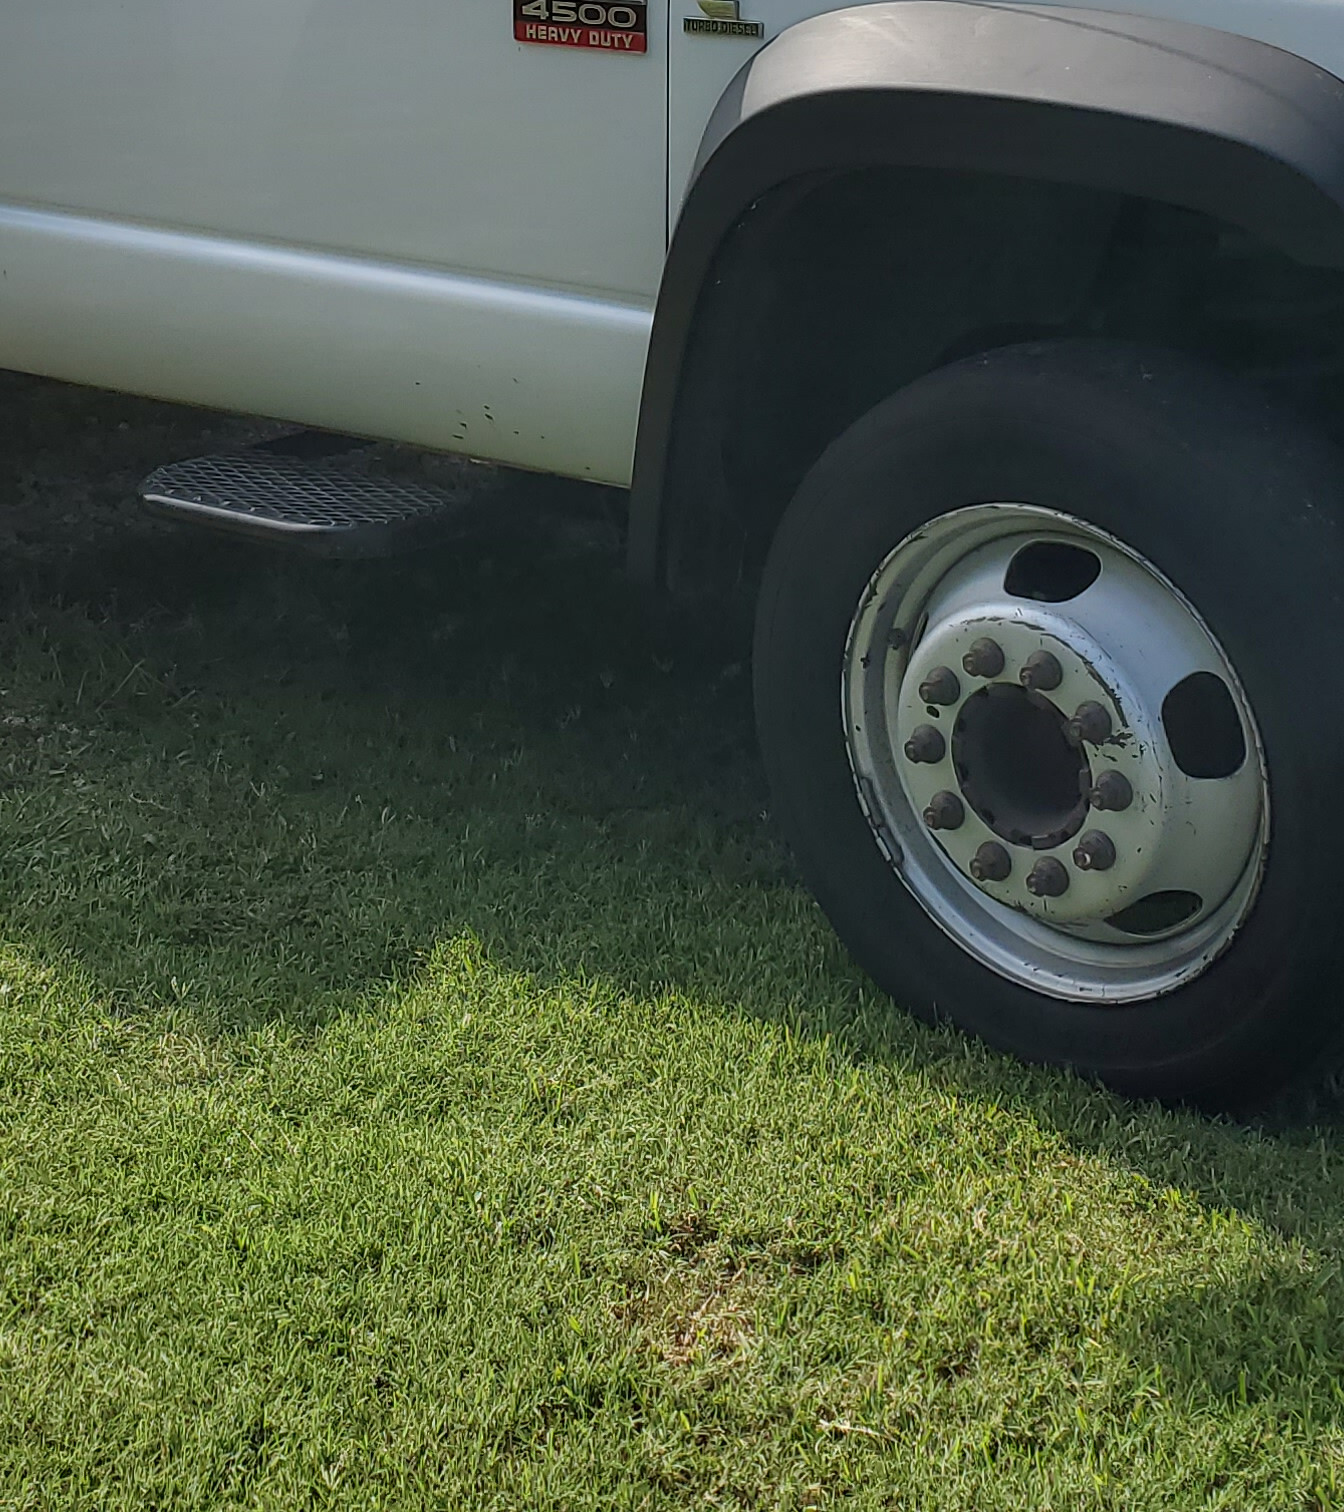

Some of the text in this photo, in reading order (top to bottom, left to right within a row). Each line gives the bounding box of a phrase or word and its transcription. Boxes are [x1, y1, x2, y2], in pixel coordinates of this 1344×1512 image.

[521, 0, 637, 28] 4500
[525, 24, 634, 49] HEAVY DUTY
